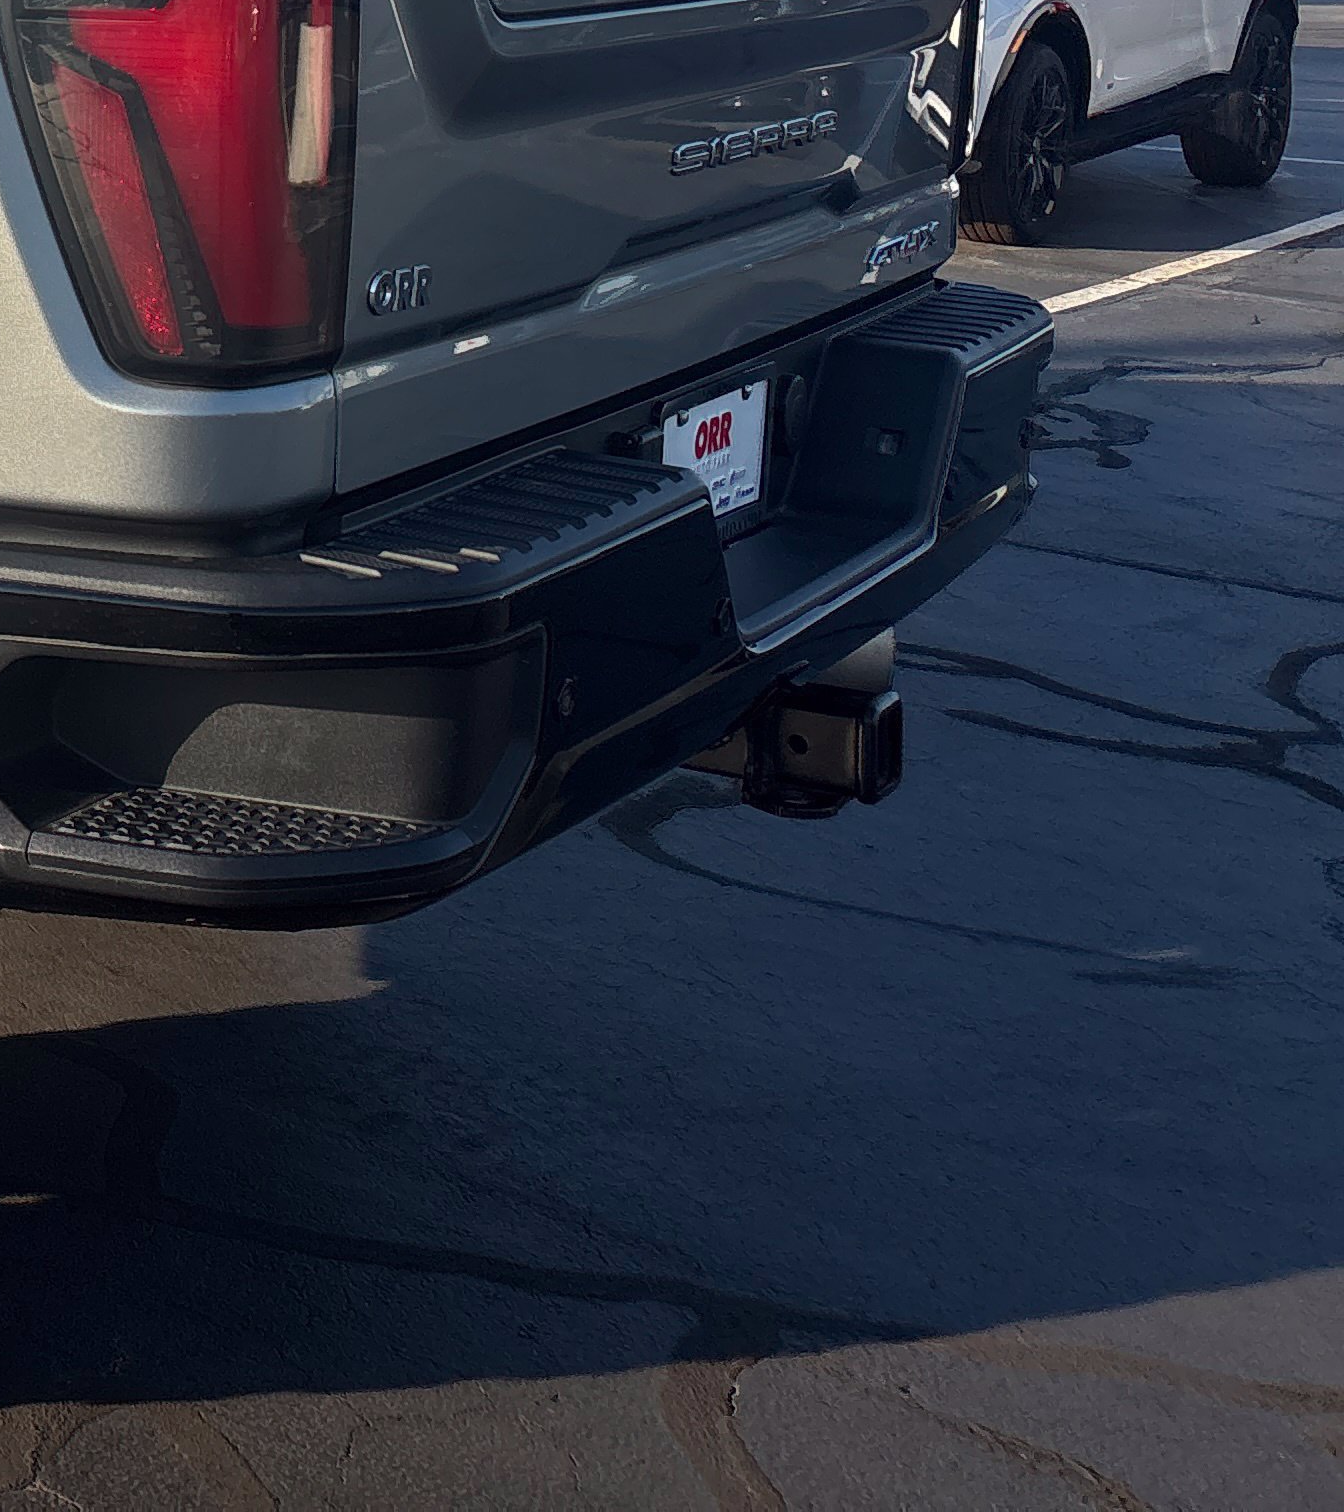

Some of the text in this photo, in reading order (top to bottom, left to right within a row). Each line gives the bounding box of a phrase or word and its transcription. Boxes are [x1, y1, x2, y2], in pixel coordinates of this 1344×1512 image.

[669, 109, 839, 176] SIERRA
[367, 264, 433, 316] ORR
[694, 411, 733, 460] ORR
